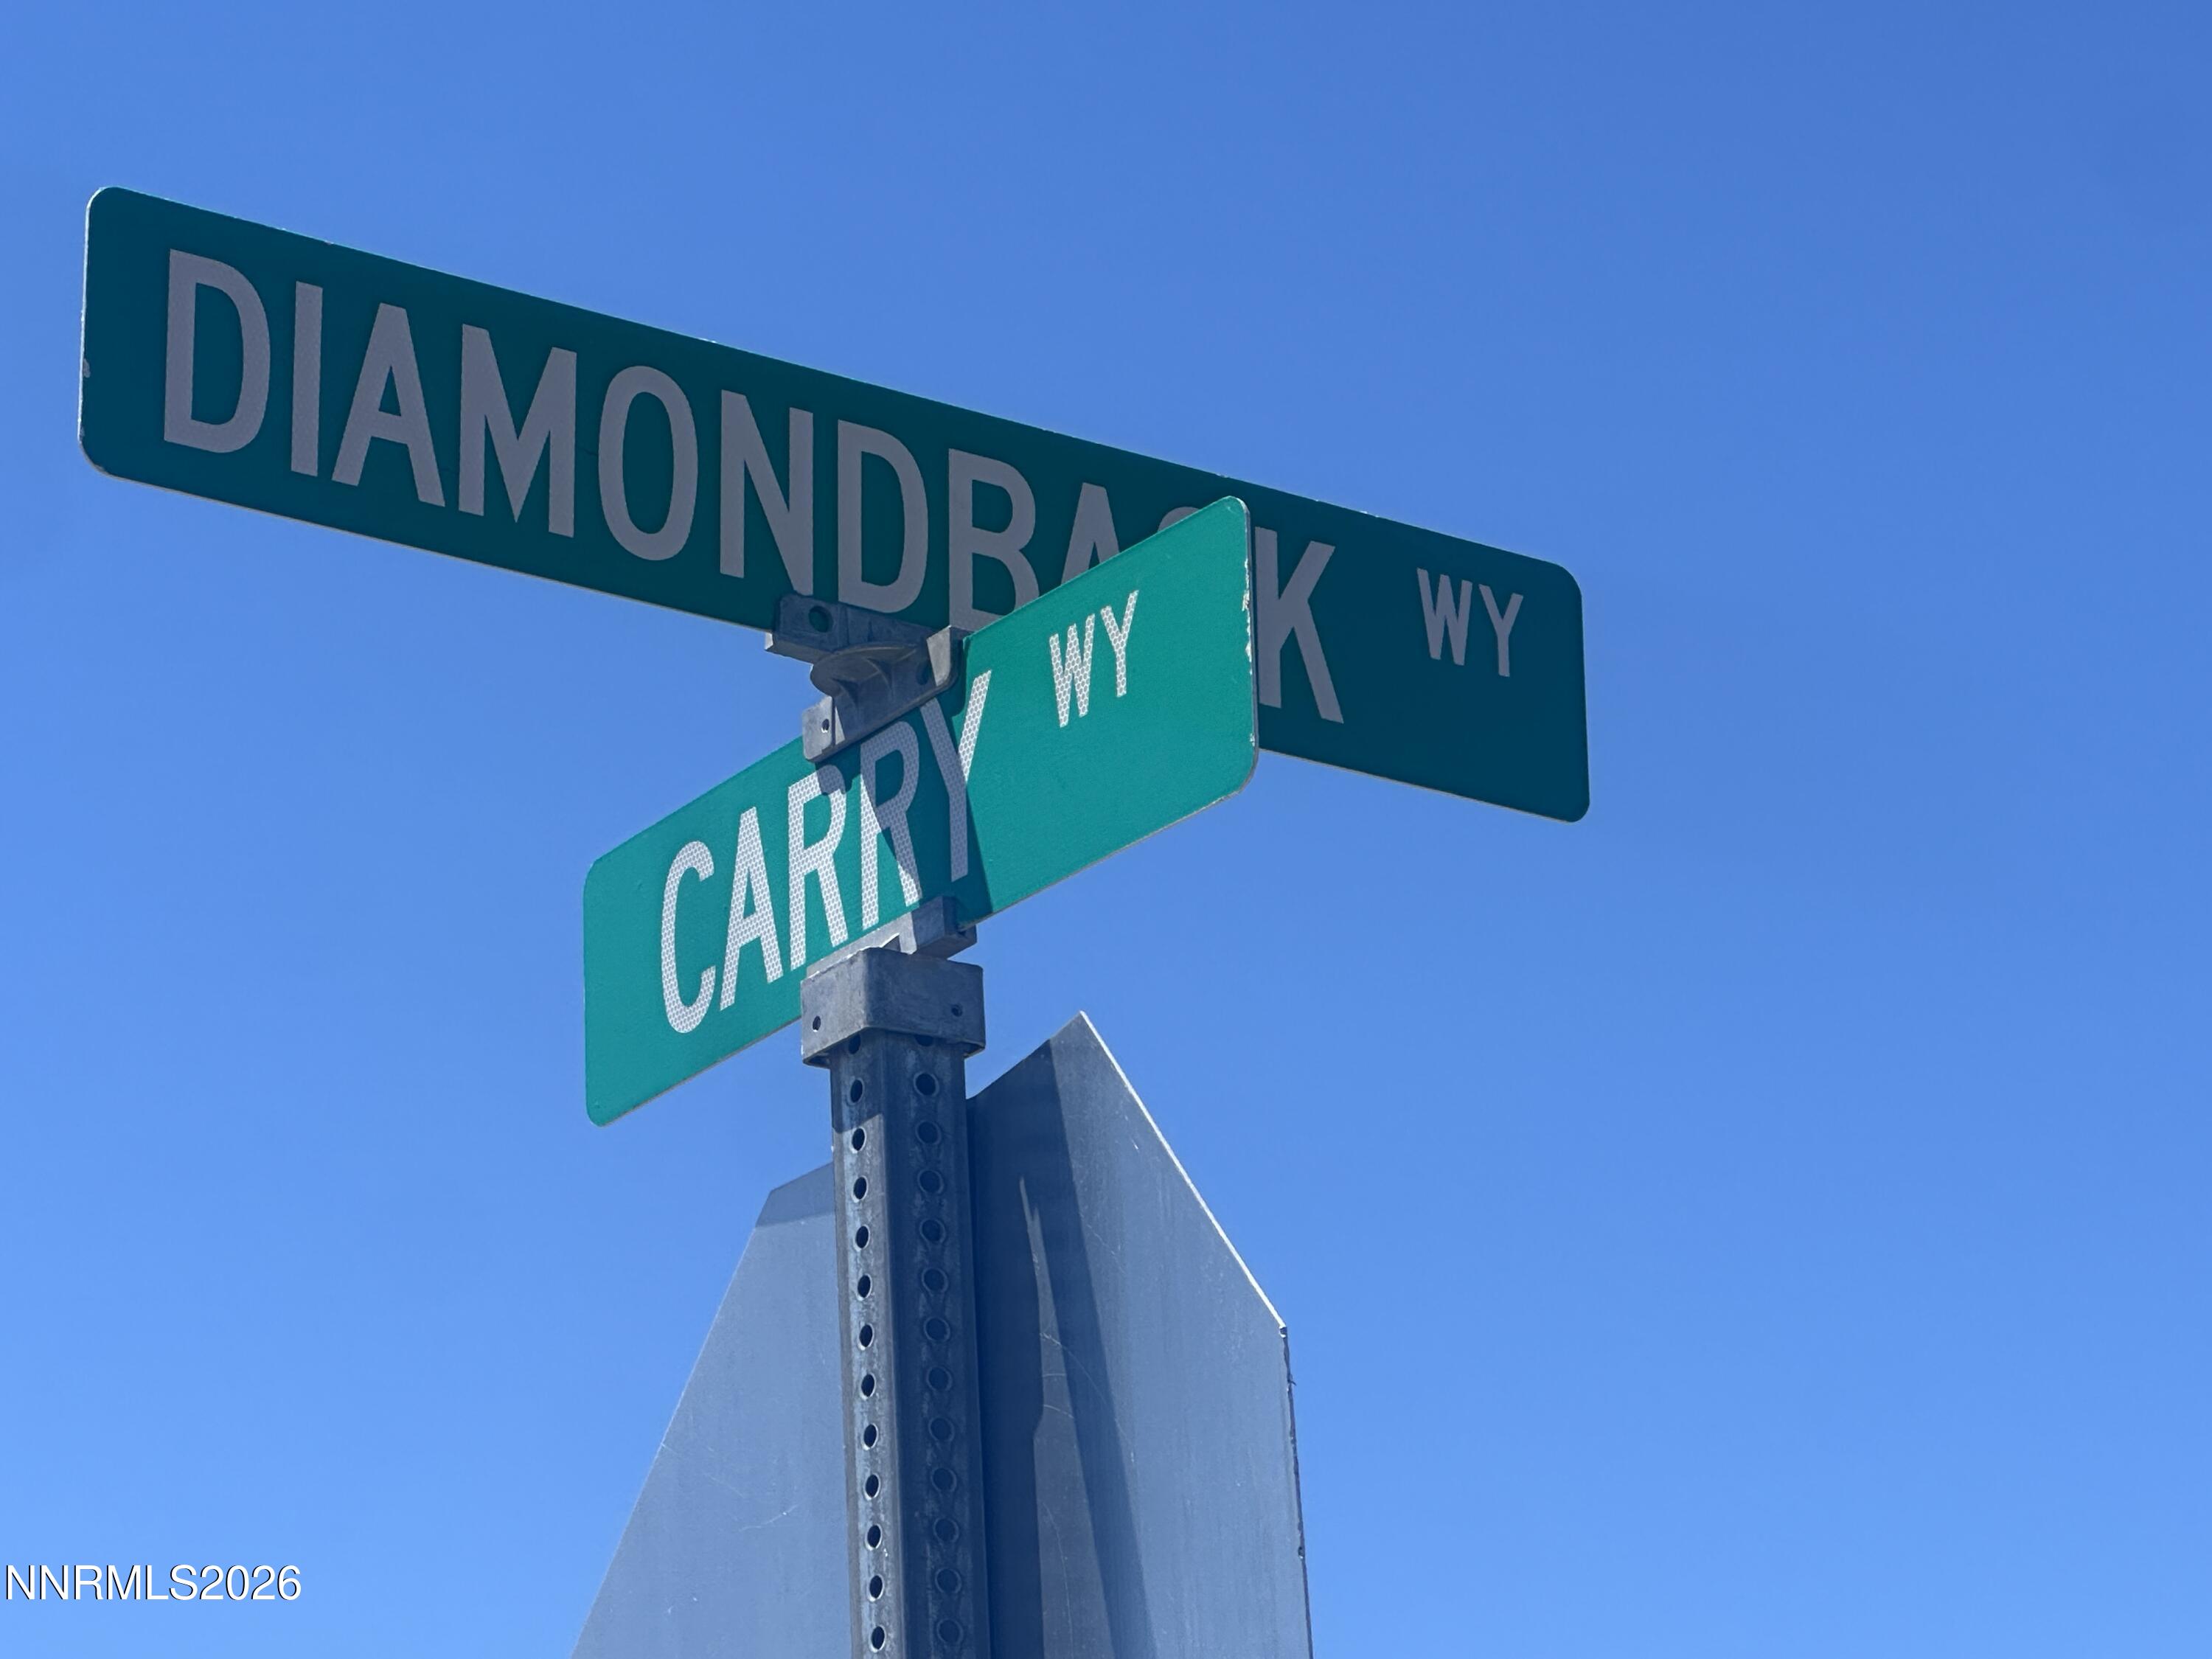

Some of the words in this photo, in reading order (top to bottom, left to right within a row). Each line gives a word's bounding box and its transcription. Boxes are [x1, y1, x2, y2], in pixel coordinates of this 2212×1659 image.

[164, 248, 1344, 725] DIAMONDBK
[1416, 568, 1524, 678] WY
[661, 669, 992, 1034] CARRY
[1048, 590, 1139, 728] WY
